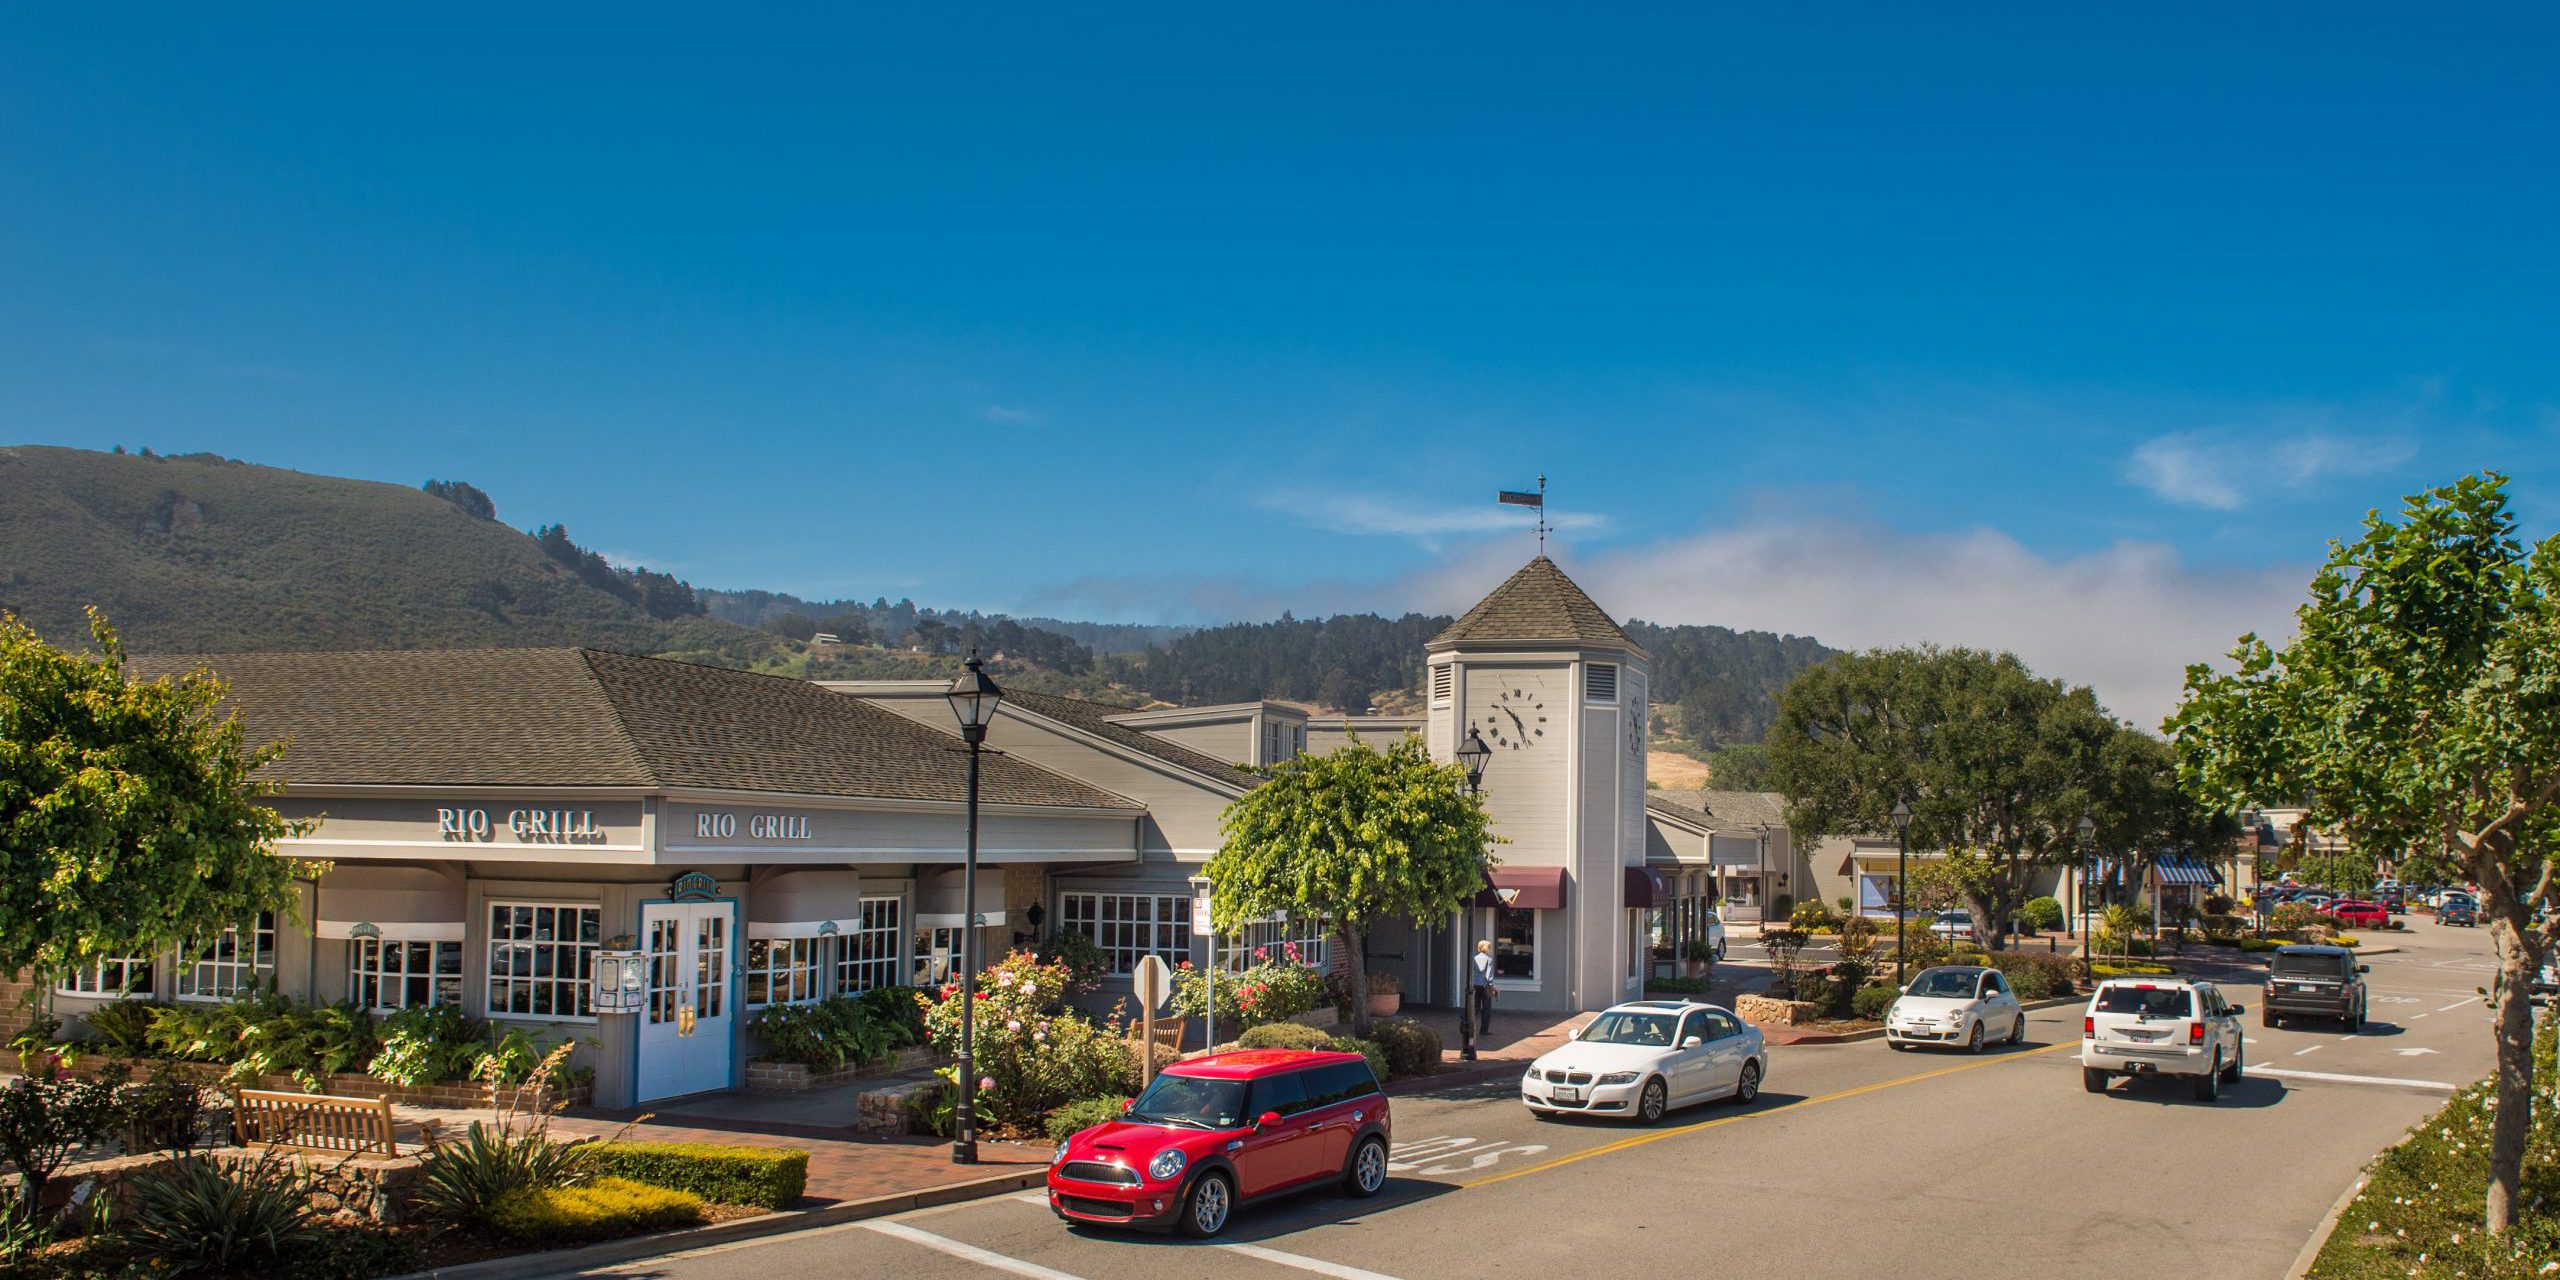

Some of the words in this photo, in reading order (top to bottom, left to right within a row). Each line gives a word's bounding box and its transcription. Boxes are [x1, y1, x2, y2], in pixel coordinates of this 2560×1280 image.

[436, 808, 490, 833] RIO
[508, 810, 599, 834] GRILL
[696, 813, 736, 838] RIO
[750, 814, 812, 839] GRILL
